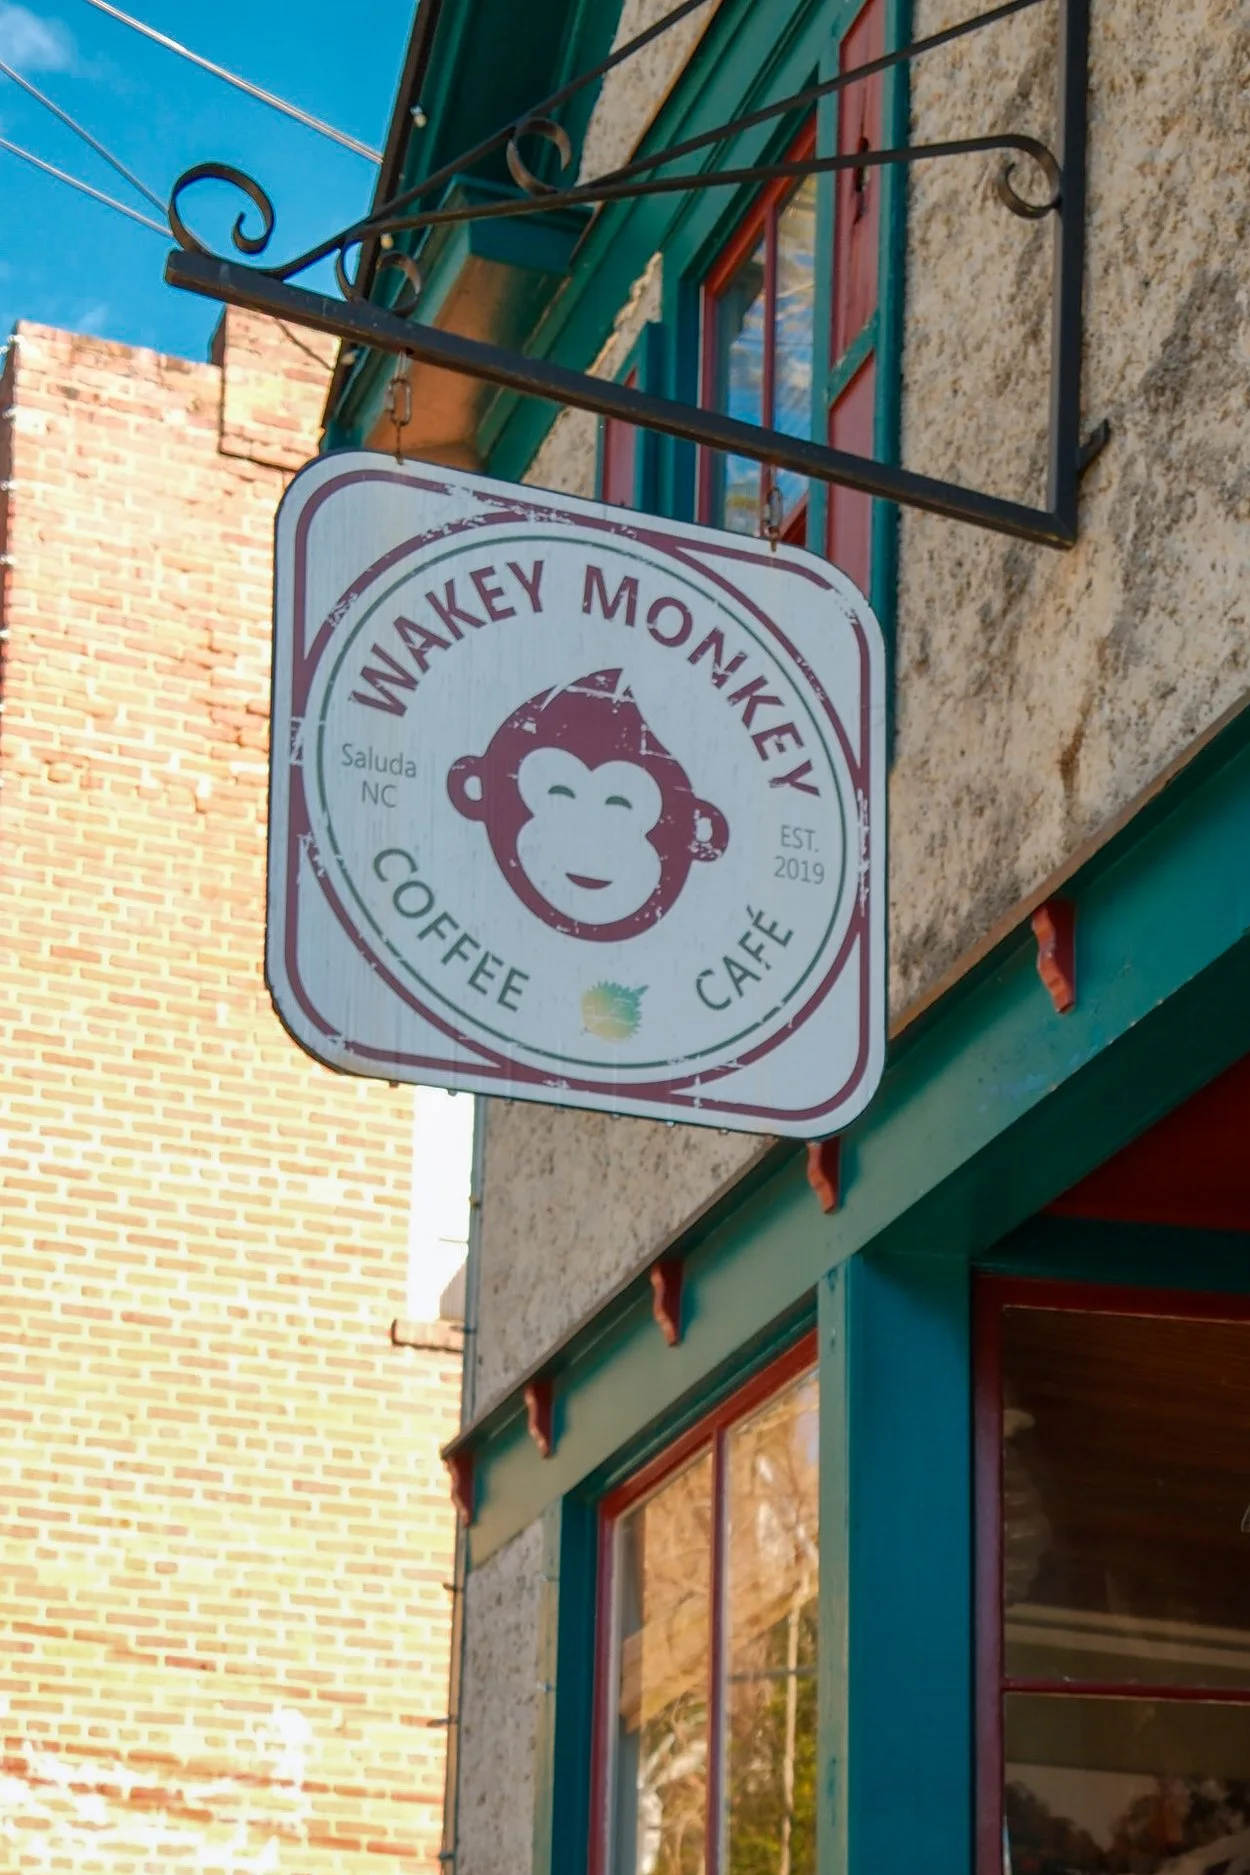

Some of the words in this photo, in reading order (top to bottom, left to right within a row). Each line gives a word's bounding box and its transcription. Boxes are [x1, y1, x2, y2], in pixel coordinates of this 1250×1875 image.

[349, 559, 545, 719] WAKEY
[581, 563, 821, 799] MONKEY
[340, 742, 418, 780] Saluda
[361, 783, 398, 809] NC
[780, 824, 820, 852] EST.
[773, 855, 825, 886] 2019
[372, 846, 532, 1013] COFFEE
[695, 903, 794, 1013] CAFÉ
